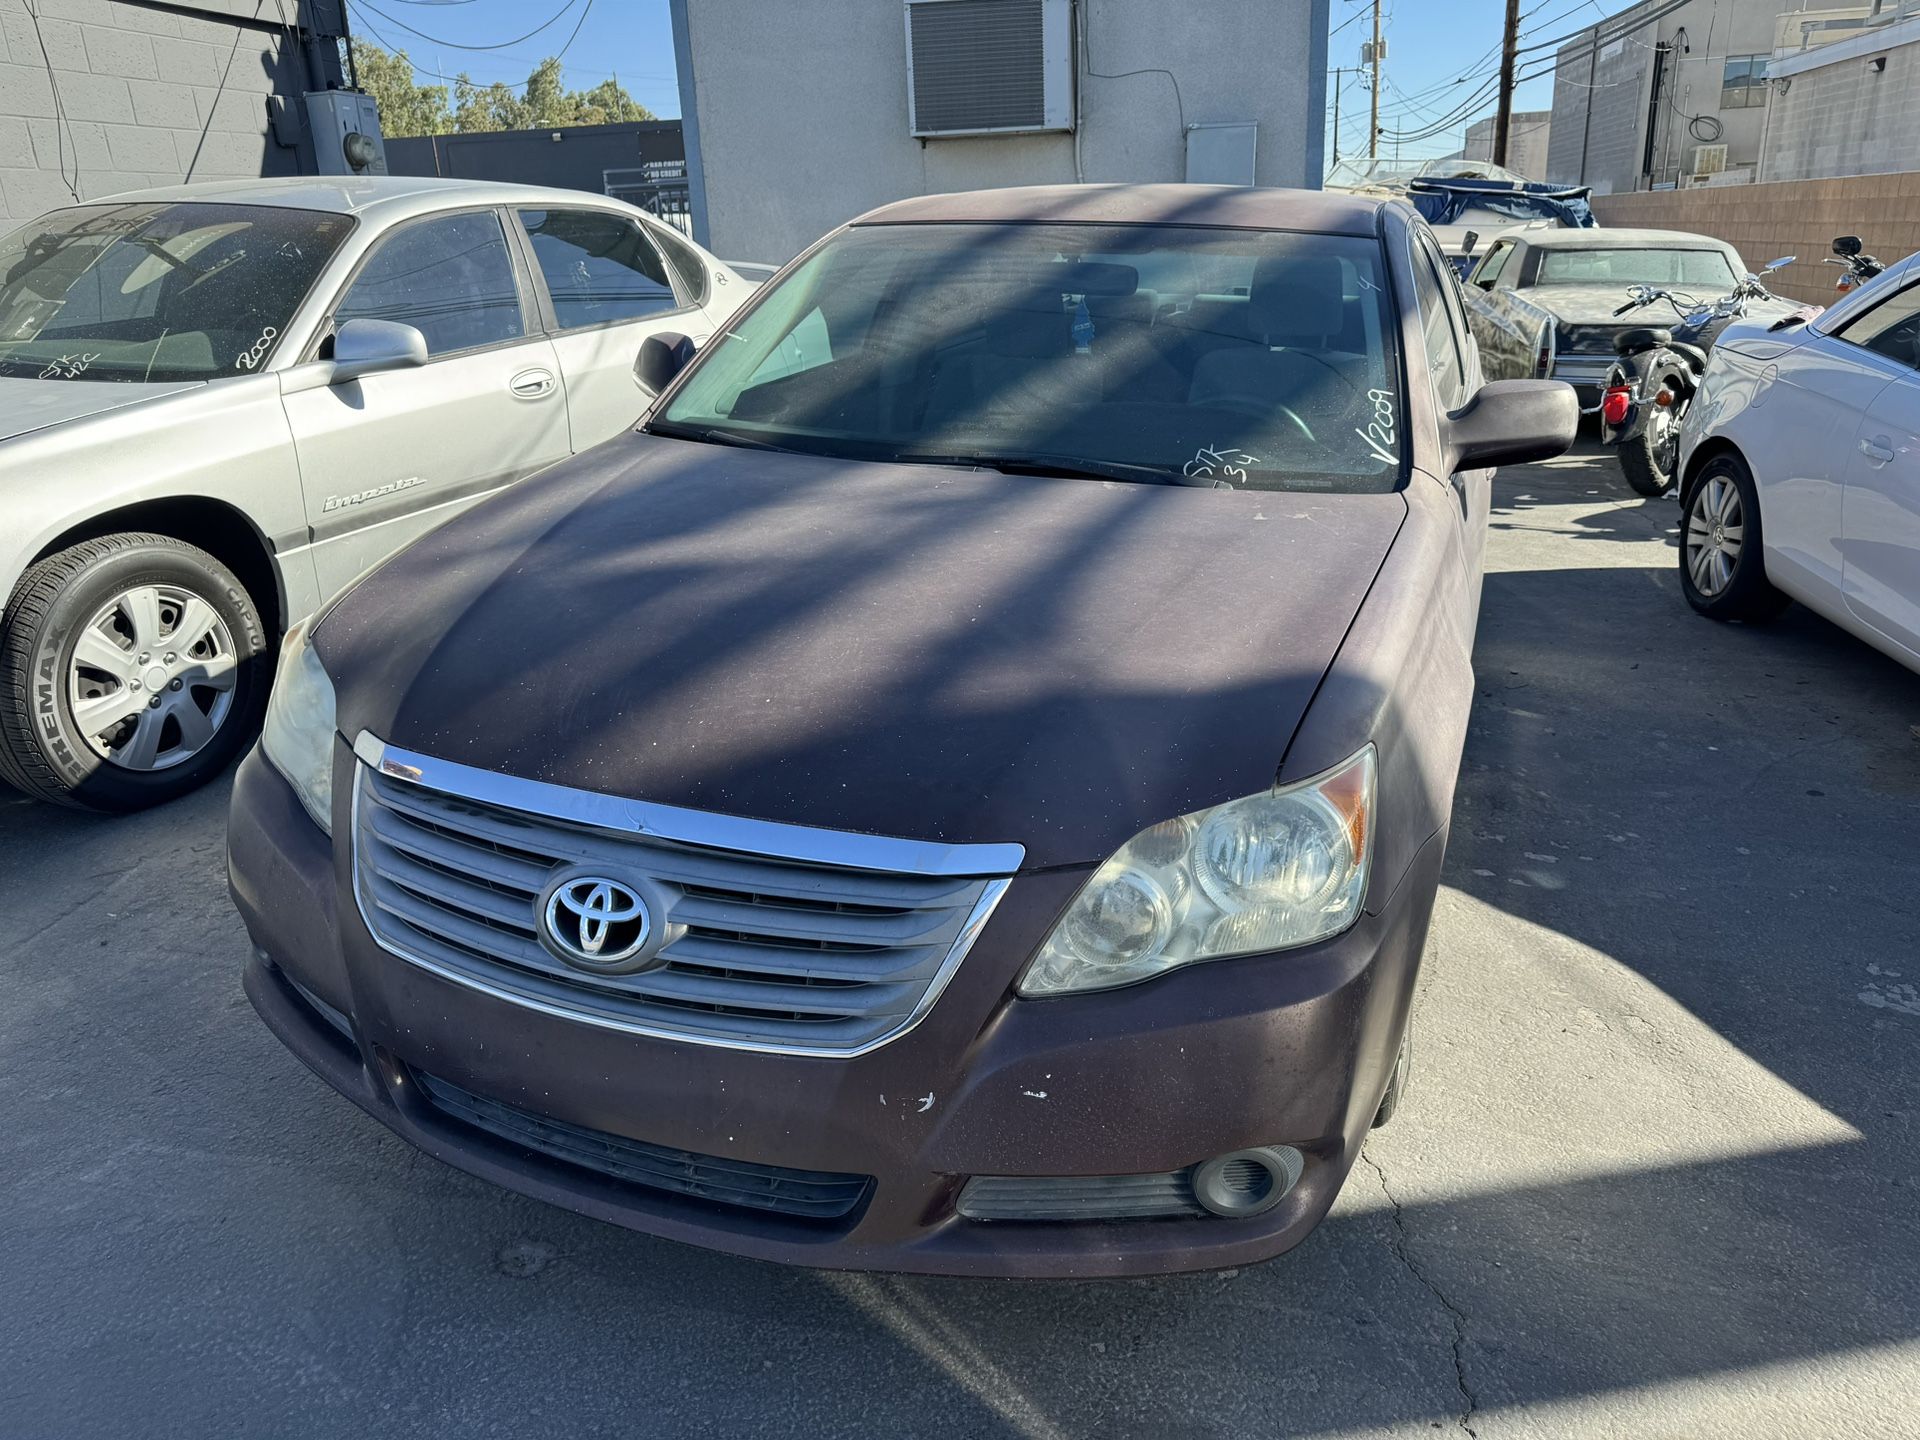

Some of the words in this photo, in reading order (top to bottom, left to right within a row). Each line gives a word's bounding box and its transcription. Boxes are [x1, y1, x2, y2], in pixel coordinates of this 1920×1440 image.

[235, 326, 277, 369] 2000
[1183, 443, 1242, 477] STK
[1223, 454, 1261, 484] 34
[322, 477, 427, 513] Impala
